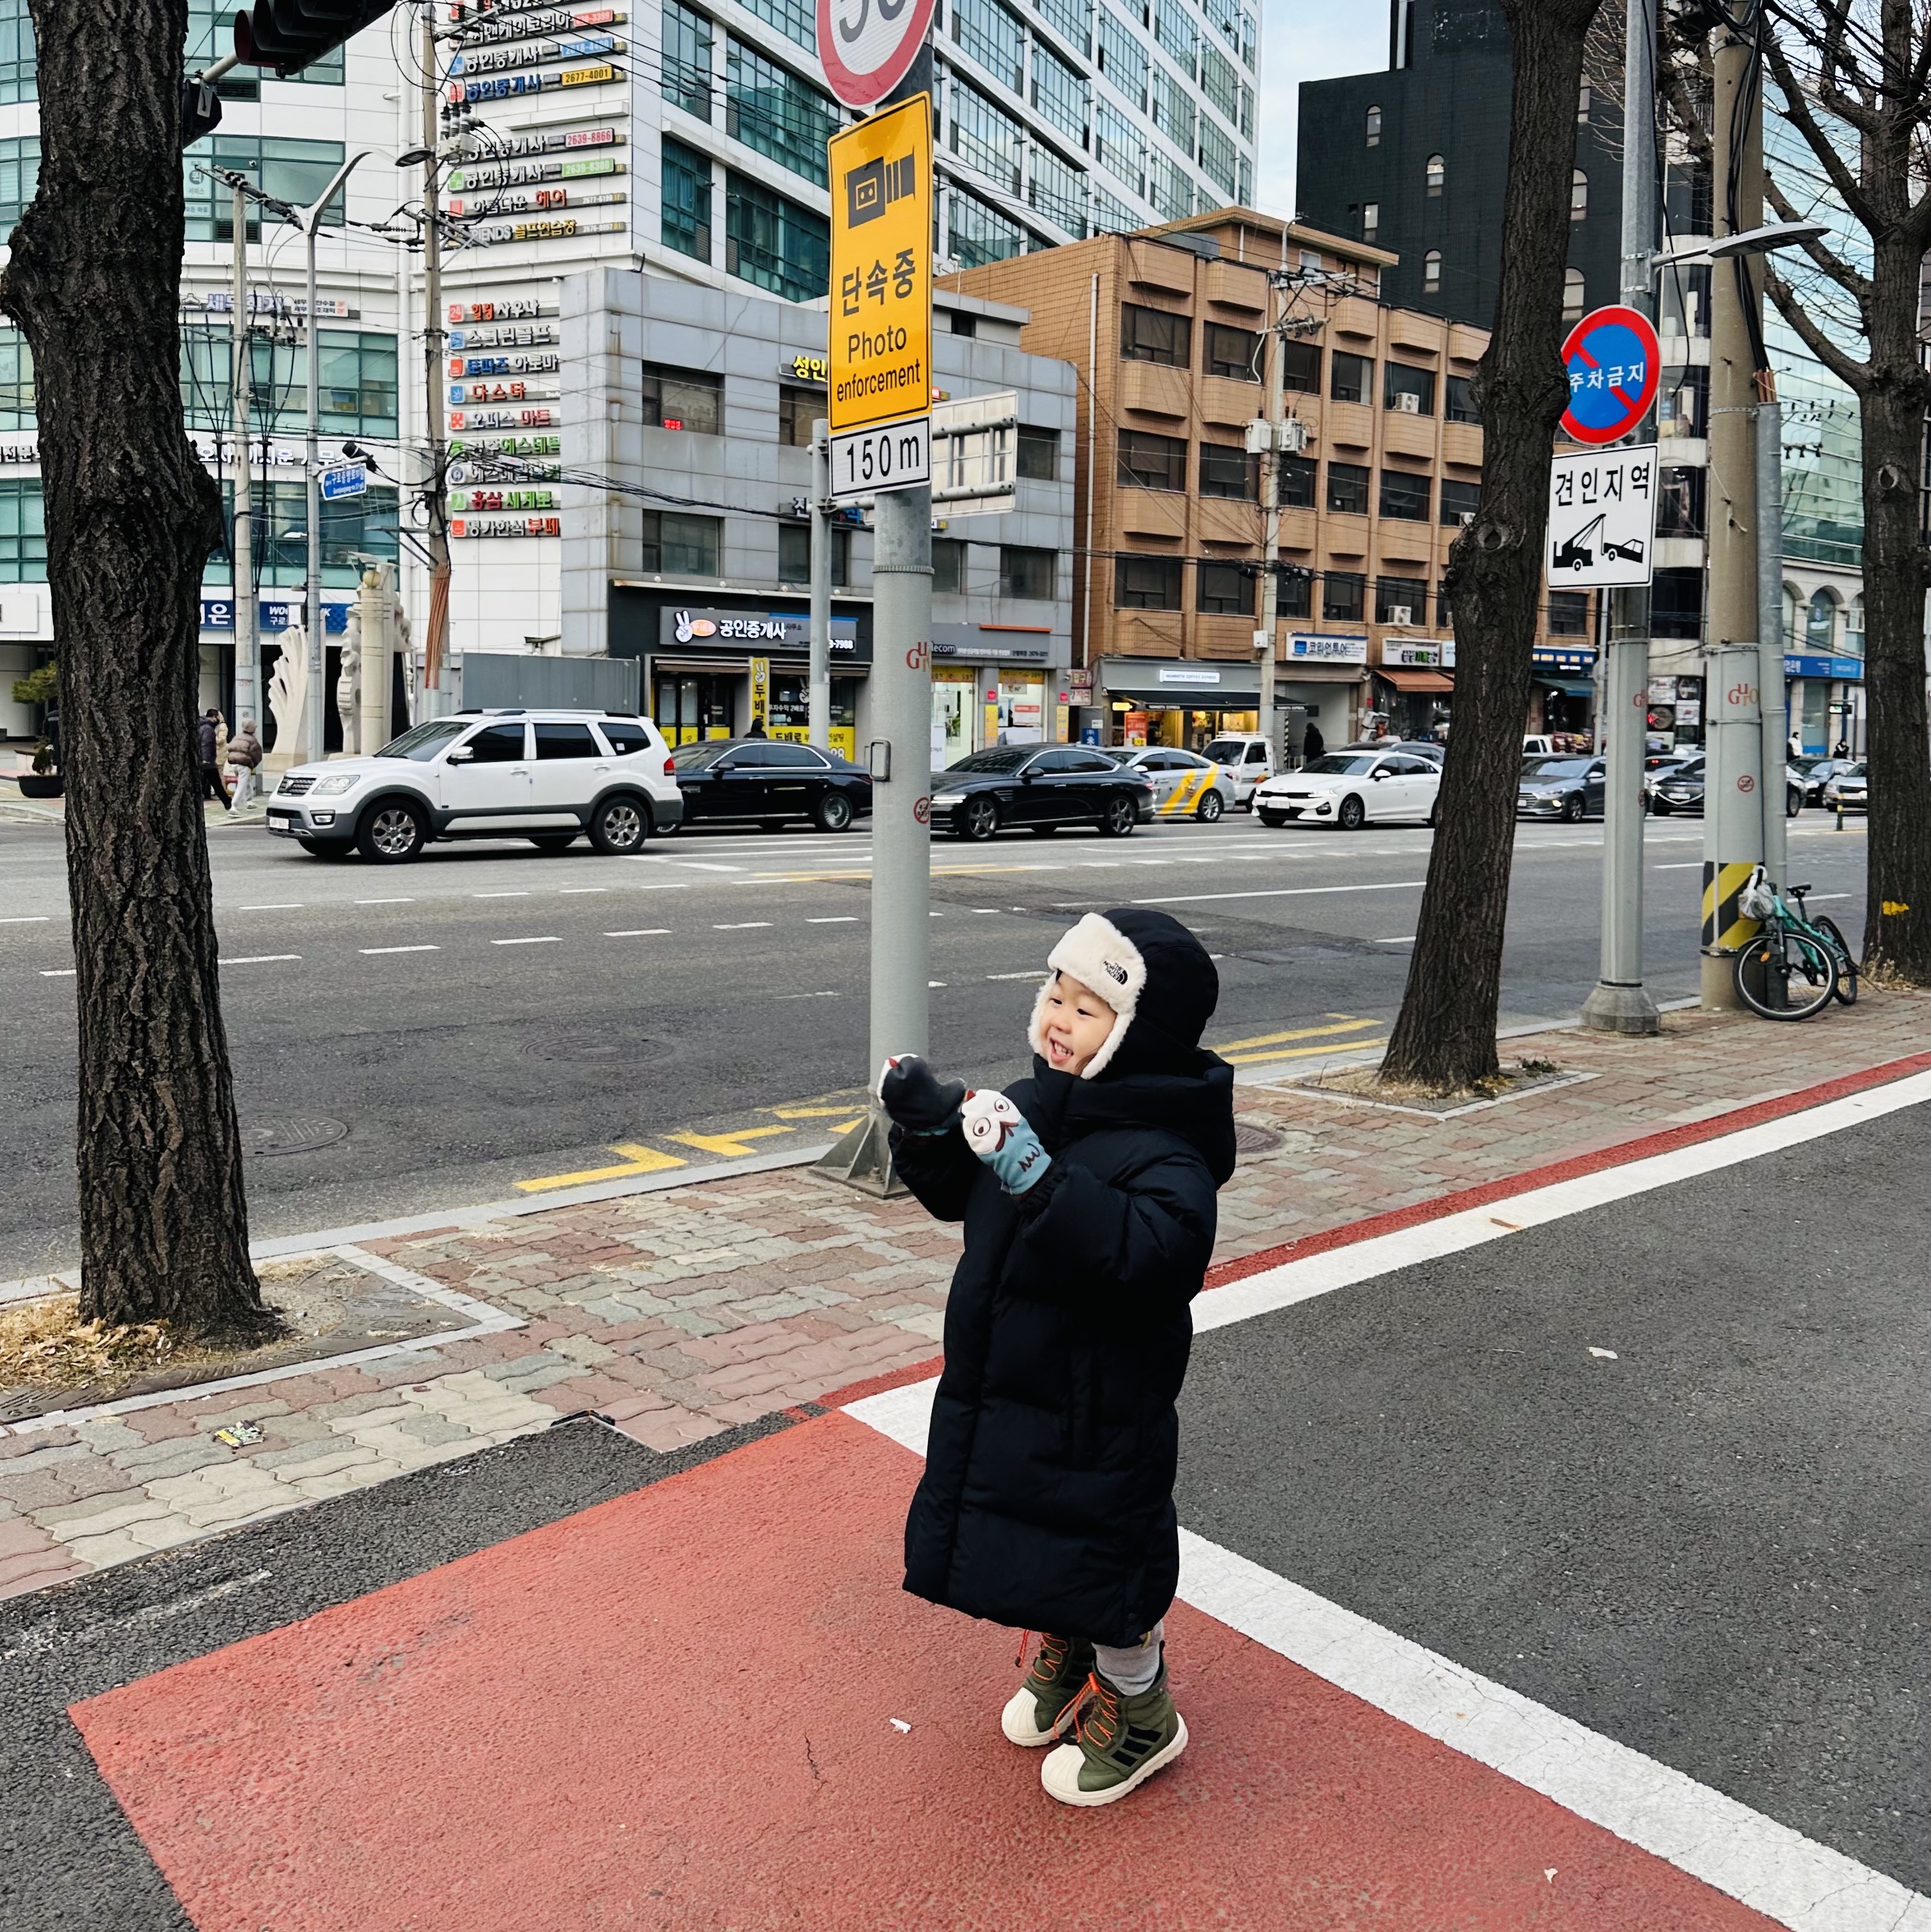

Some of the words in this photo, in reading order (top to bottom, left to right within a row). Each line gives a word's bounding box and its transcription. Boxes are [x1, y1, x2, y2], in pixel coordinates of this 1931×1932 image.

[465, 46, 539, 72] 공인중개사
[466, 73, 542, 100] 공인중개사
[565, 68, 608, 83] 2677-4001
[567, 130, 611, 146] 2639-8866
[535, 189, 567, 208] 헤어
[514, 219, 577, 240] 골프연습장
[842, 247, 915, 318] 단속중
[449, 307, 462, 318] 24
[497, 299, 540, 319] 사우나
[467, 324, 551, 347] 스크린골프
[848, 324, 908, 364] Photo
[514, 354, 560, 373] 아로마
[837, 358, 921, 402] enforcement
[1569, 361, 1645, 393] 주차금지
[470, 411, 515, 429] 오피스
[521, 409, 551, 427] 마트
[847, 435, 891, 482] 150
[899, 434, 919, 470] m
[1555, 461, 1651, 507] 견인지역
[471, 491, 503, 510] 홍삼
[507, 491, 554, 509] 세계로
[468, 519, 526, 537] 명가한식
[719, 620, 787, 640] 공인중개사
